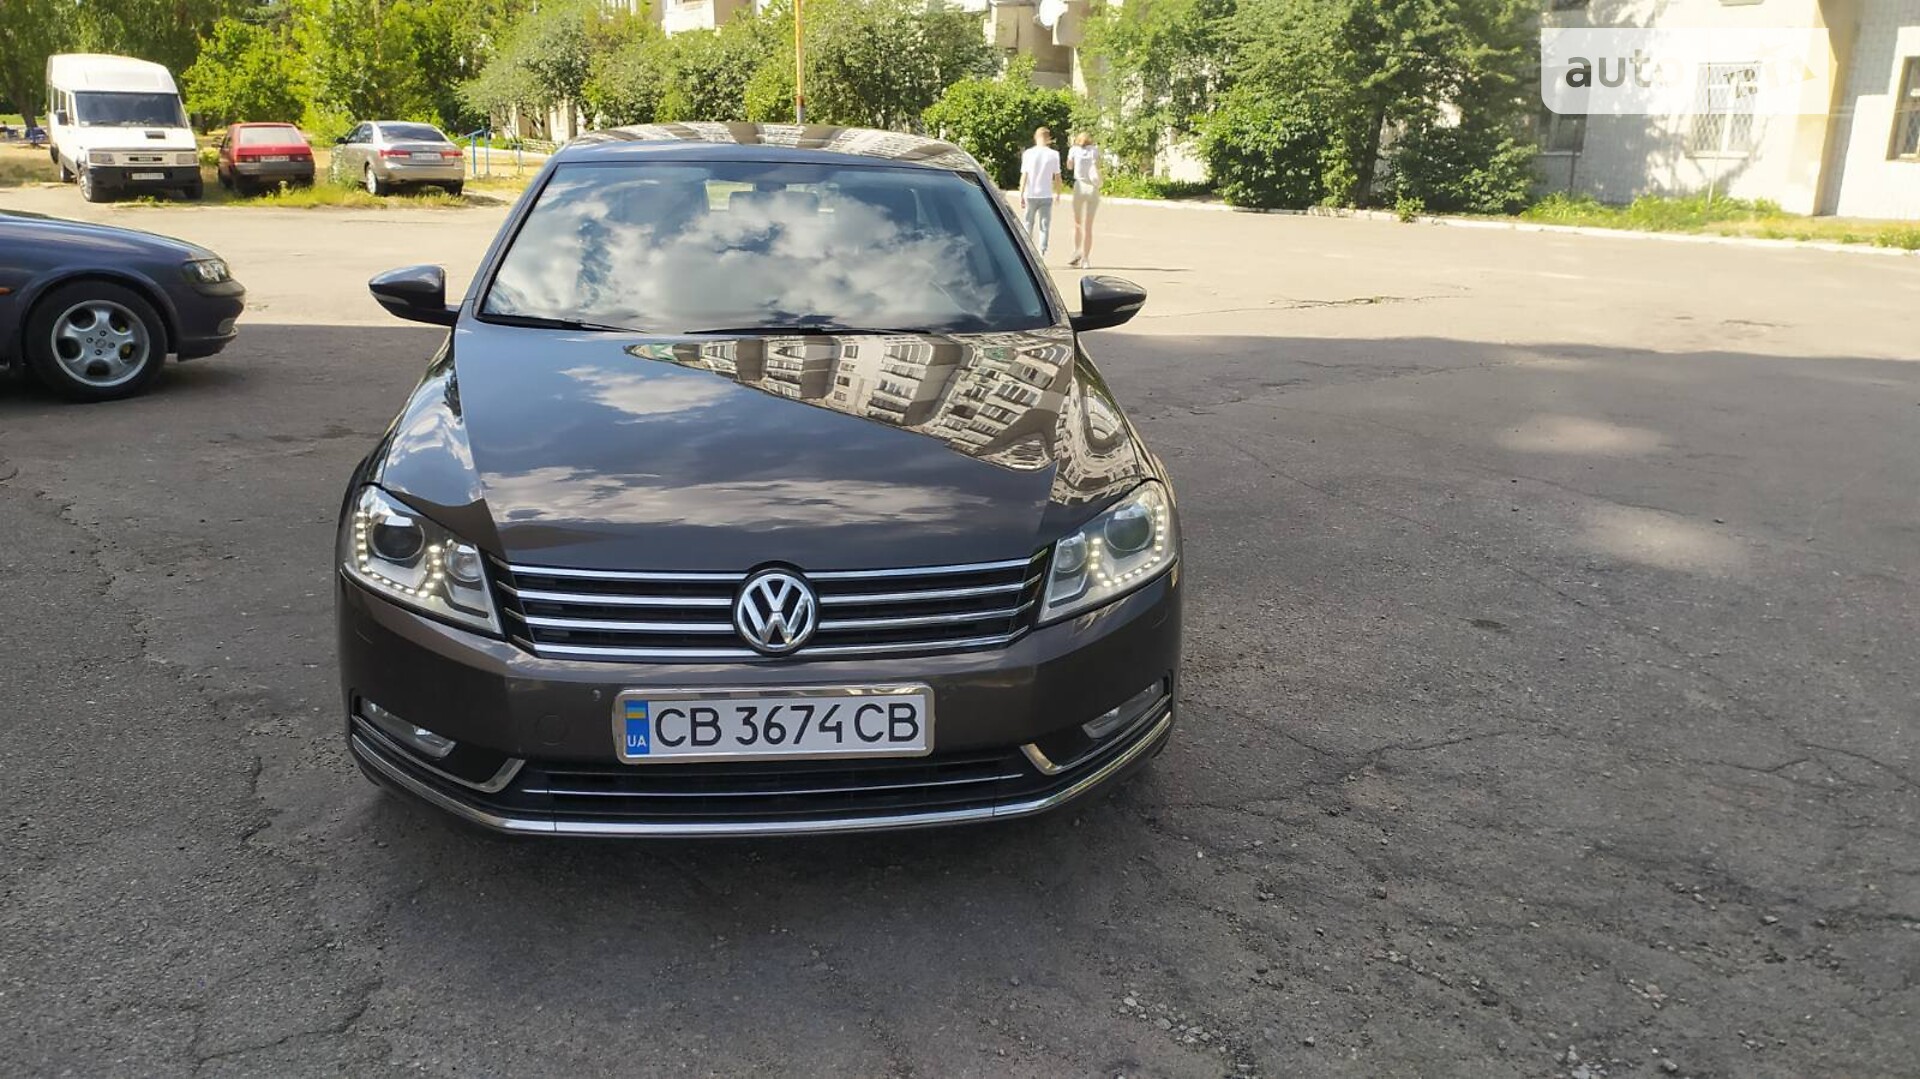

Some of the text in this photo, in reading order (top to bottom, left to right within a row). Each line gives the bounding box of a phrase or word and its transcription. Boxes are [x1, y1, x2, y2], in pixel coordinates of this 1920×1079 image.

[654, 702, 920, 747] CB 3674 CB
[626, 734, 647, 748] UA
